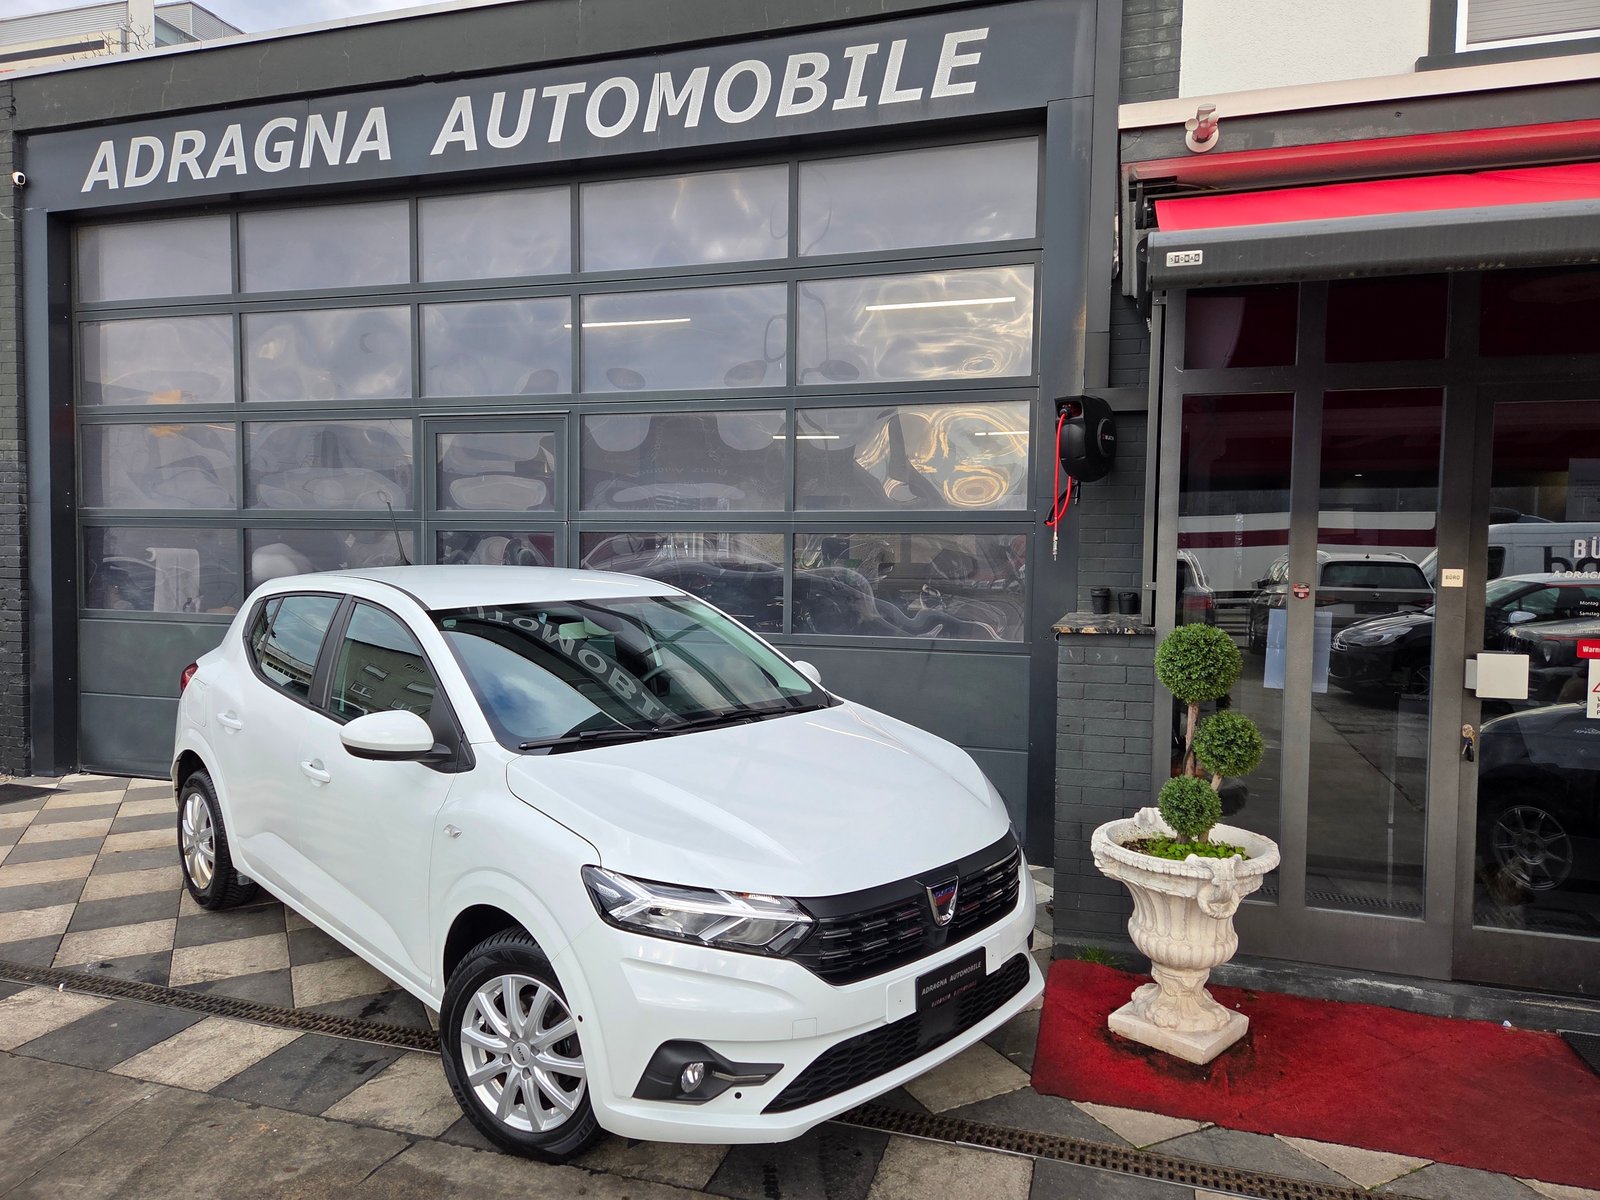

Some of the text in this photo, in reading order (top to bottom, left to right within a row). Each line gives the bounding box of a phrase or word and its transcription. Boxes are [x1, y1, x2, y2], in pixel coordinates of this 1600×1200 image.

[81, 27, 989, 192] ADRAGNA AUTOMOBILE
[921, 978, 948, 995] ADRAGNA
[950, 961, 982, 982] AUTOMOBILE
